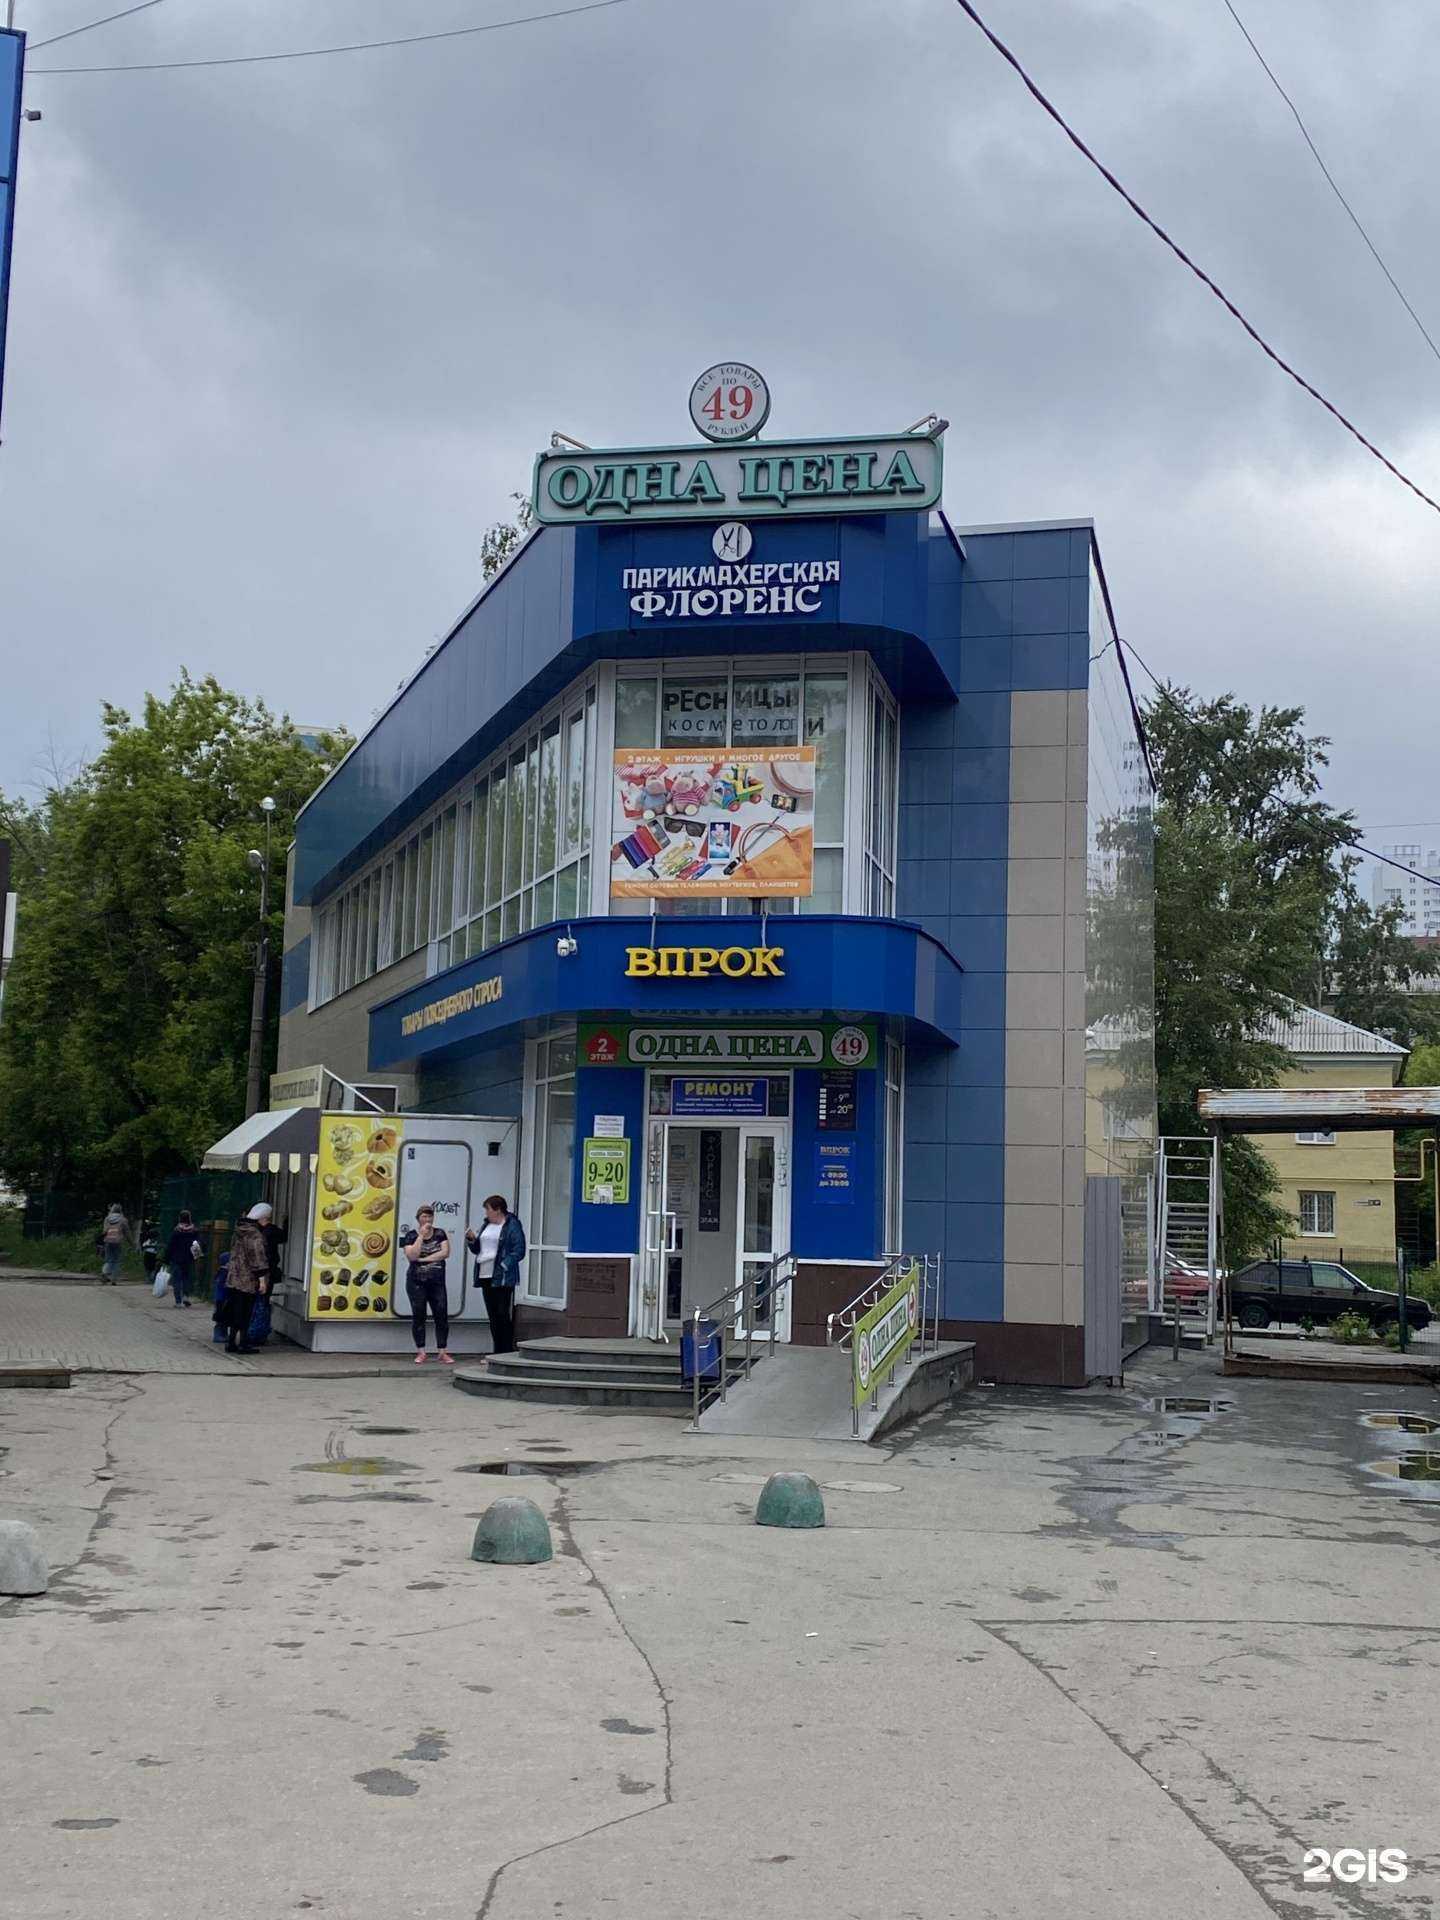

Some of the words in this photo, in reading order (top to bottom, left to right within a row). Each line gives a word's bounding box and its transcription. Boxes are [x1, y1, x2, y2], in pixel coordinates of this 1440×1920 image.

[702, 384, 753, 421] 49
[547, 459, 726, 516] ОДНА
[738, 449, 926, 508] ЦЕНА
[623, 560, 840, 590] ПАРИКМАХЕРСКАЯ
[629, 584, 823, 618] ФЛОРЕНС
[728, 753, 764, 763] МНОГОЕ
[768, 751, 800, 761] ДРУГОЕ
[625, 947, 785, 977] ВПРОК
[598, 1038, 608, 1053] 2
[635, 1034, 723, 1061] ОДНА
[727, 1034, 816, 1061] ЦЕНА
[835, 1037, 863, 1057] 49
[684, 1082, 754, 1096] РЕМОНТ
[588, 1162, 624, 1183] 9-20
